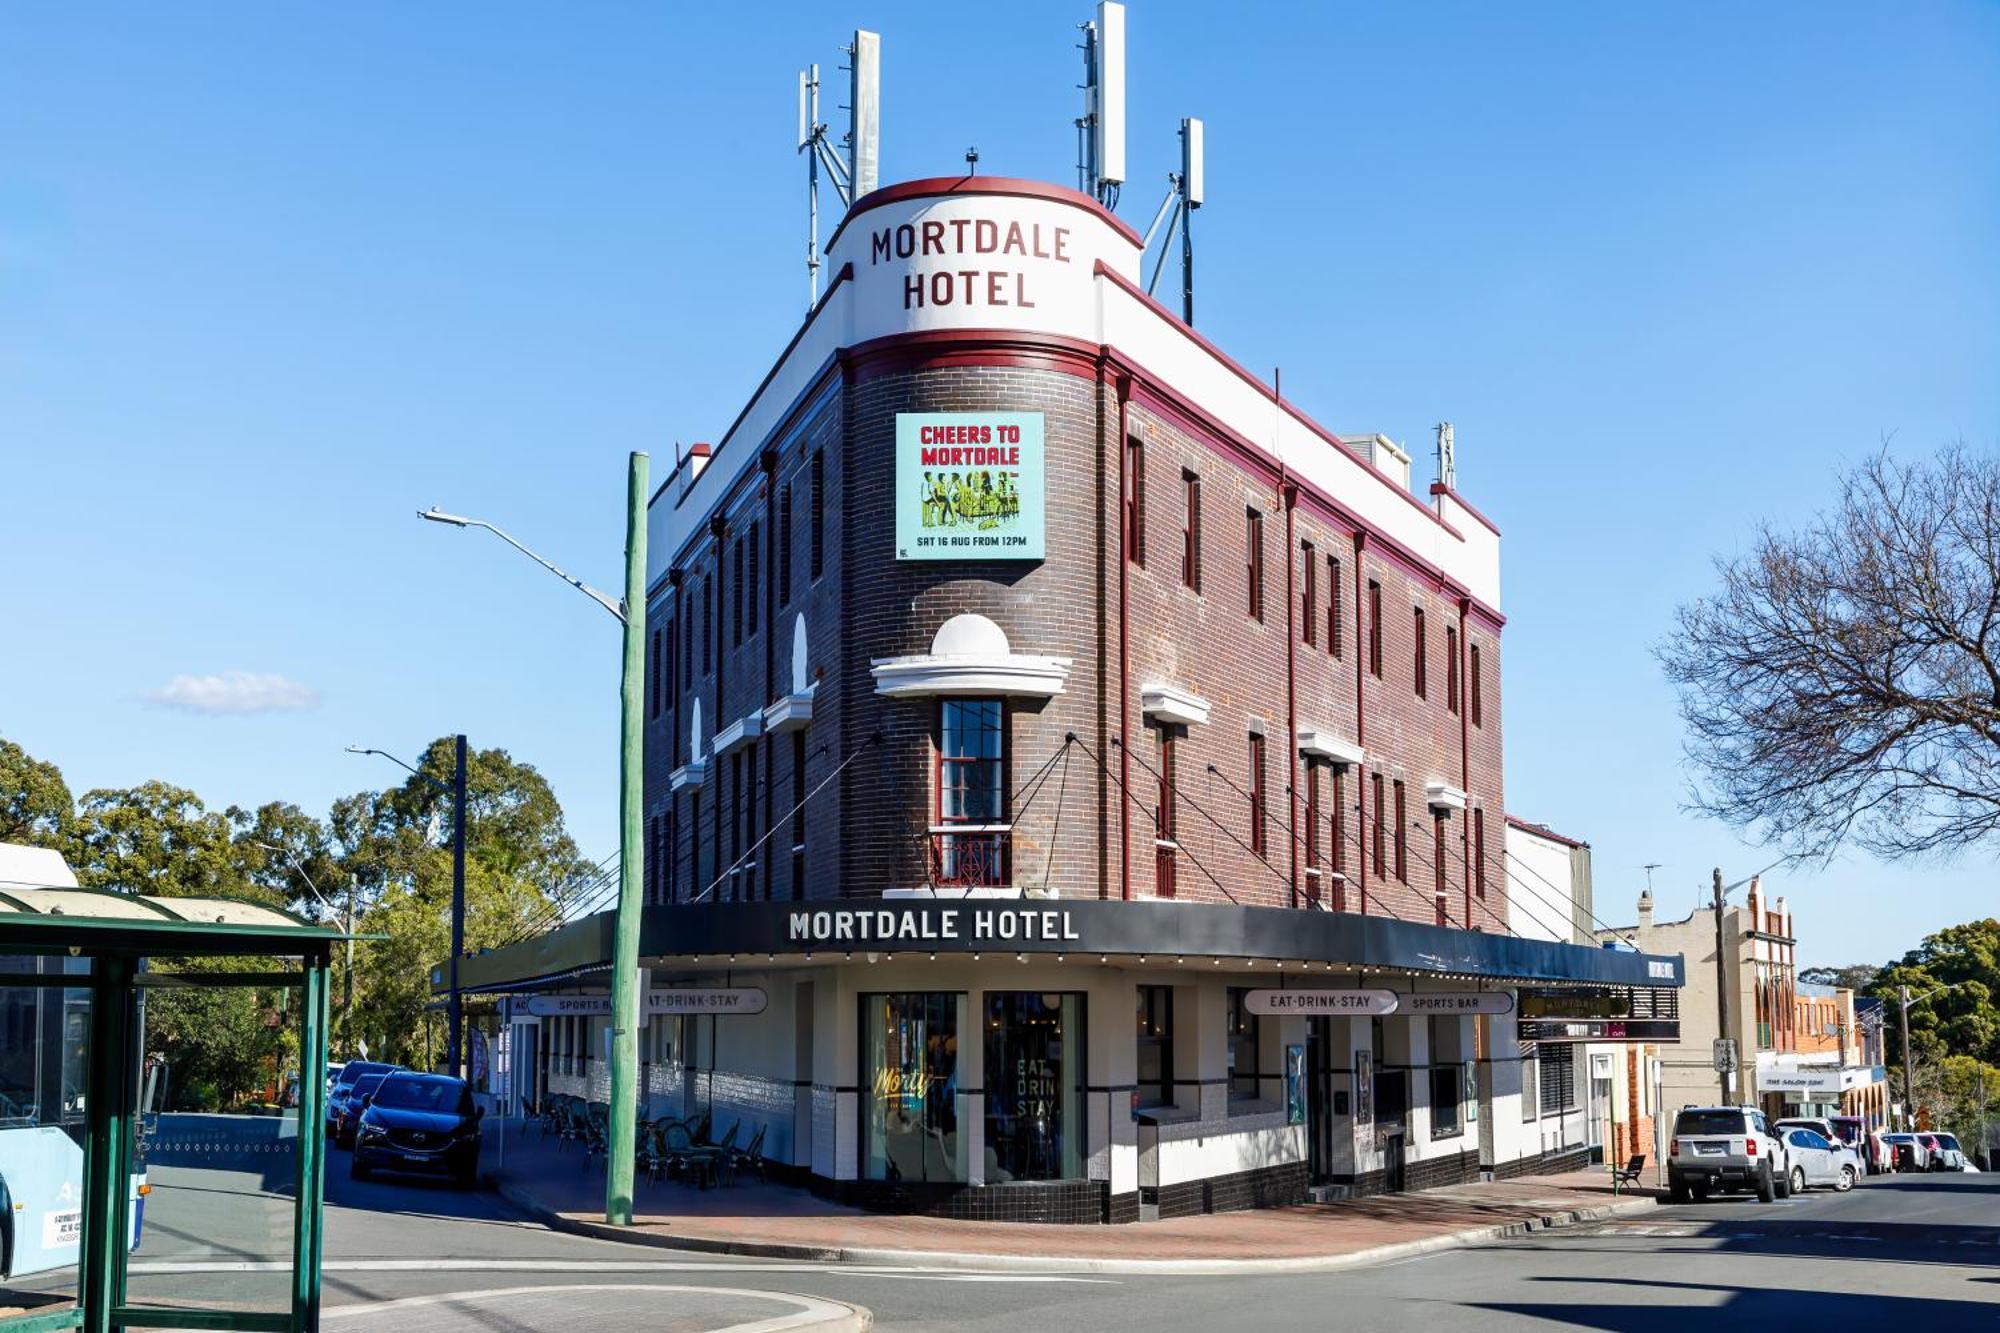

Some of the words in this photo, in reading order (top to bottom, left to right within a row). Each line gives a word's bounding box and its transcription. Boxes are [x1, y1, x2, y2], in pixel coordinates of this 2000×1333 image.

[872, 219, 1070, 266] MORTDALE
[904, 271, 1035, 310] HOTEL
[920, 425, 992, 445] CHEERS
[996, 425, 1021, 444] TO
[920, 446, 1020, 466] MORTDALE
[917, 536, 935, 547] SAT
[937, 536, 949, 546] 16
[951, 536, 971, 546] AUG
[973, 536, 1000, 546] FROM
[1002, 536, 1027, 546] 12PM
[789, 910, 959, 940] MORTDALE
[974, 910, 1080, 940] HOTEL
[559, 1000, 599, 1011] SPORTS
[1412, 998, 1454, 1009] SPORTS
[1458, 998, 1480, 1009] BAR
[1018, 1060, 1046, 1076] EAT
[1018, 1080, 1055, 1096] DRIN
[1017, 1100, 1054, 1116] STAY
